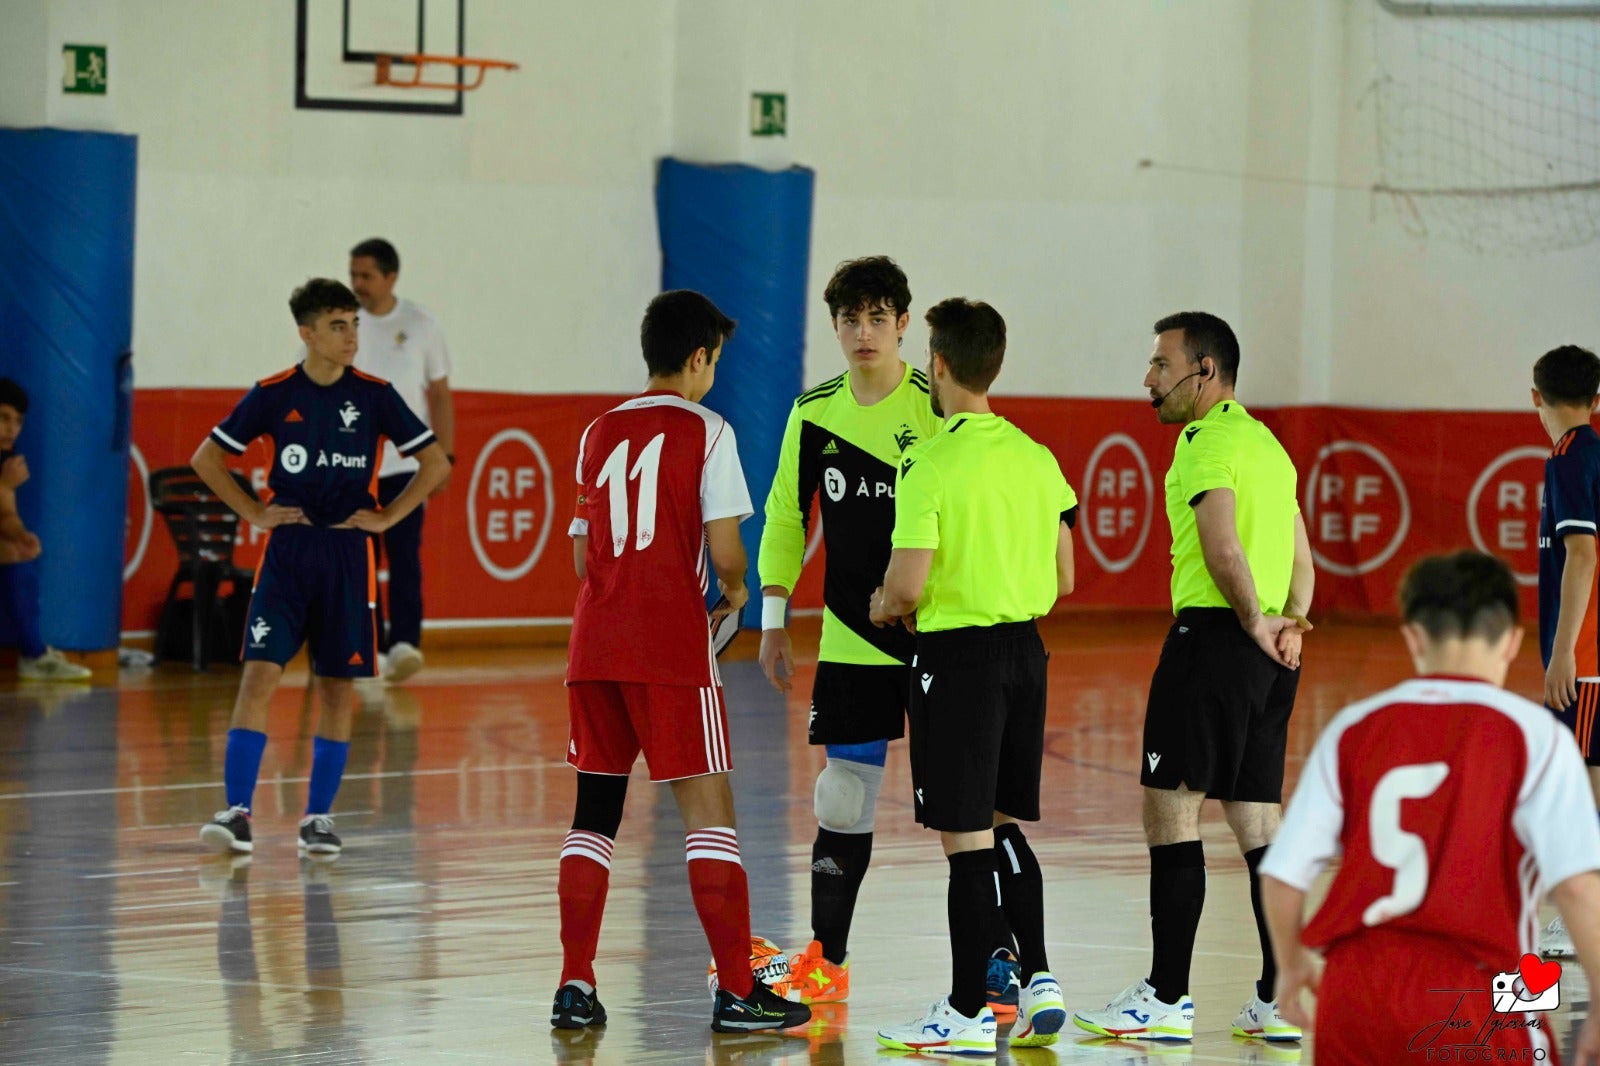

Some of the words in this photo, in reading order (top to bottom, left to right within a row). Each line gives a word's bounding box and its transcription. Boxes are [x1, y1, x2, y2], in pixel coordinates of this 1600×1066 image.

[316, 450, 329, 467] À
[331, 452, 368, 469] Punt
[487, 466, 536, 500] RF
[595, 432, 665, 558] 11
[856, 476, 870, 497] À
[875, 481, 896, 498] Pu
[1097, 468, 1138, 498] RF
[1320, 473, 1383, 505] RF
[1497, 480, 1545, 511] R
[486, 508, 535, 543] EF
[1096, 507, 1136, 538] EF
[1320, 512, 1382, 543] EF
[1498, 520, 1540, 550] E
[1362, 761, 1451, 928] 5
